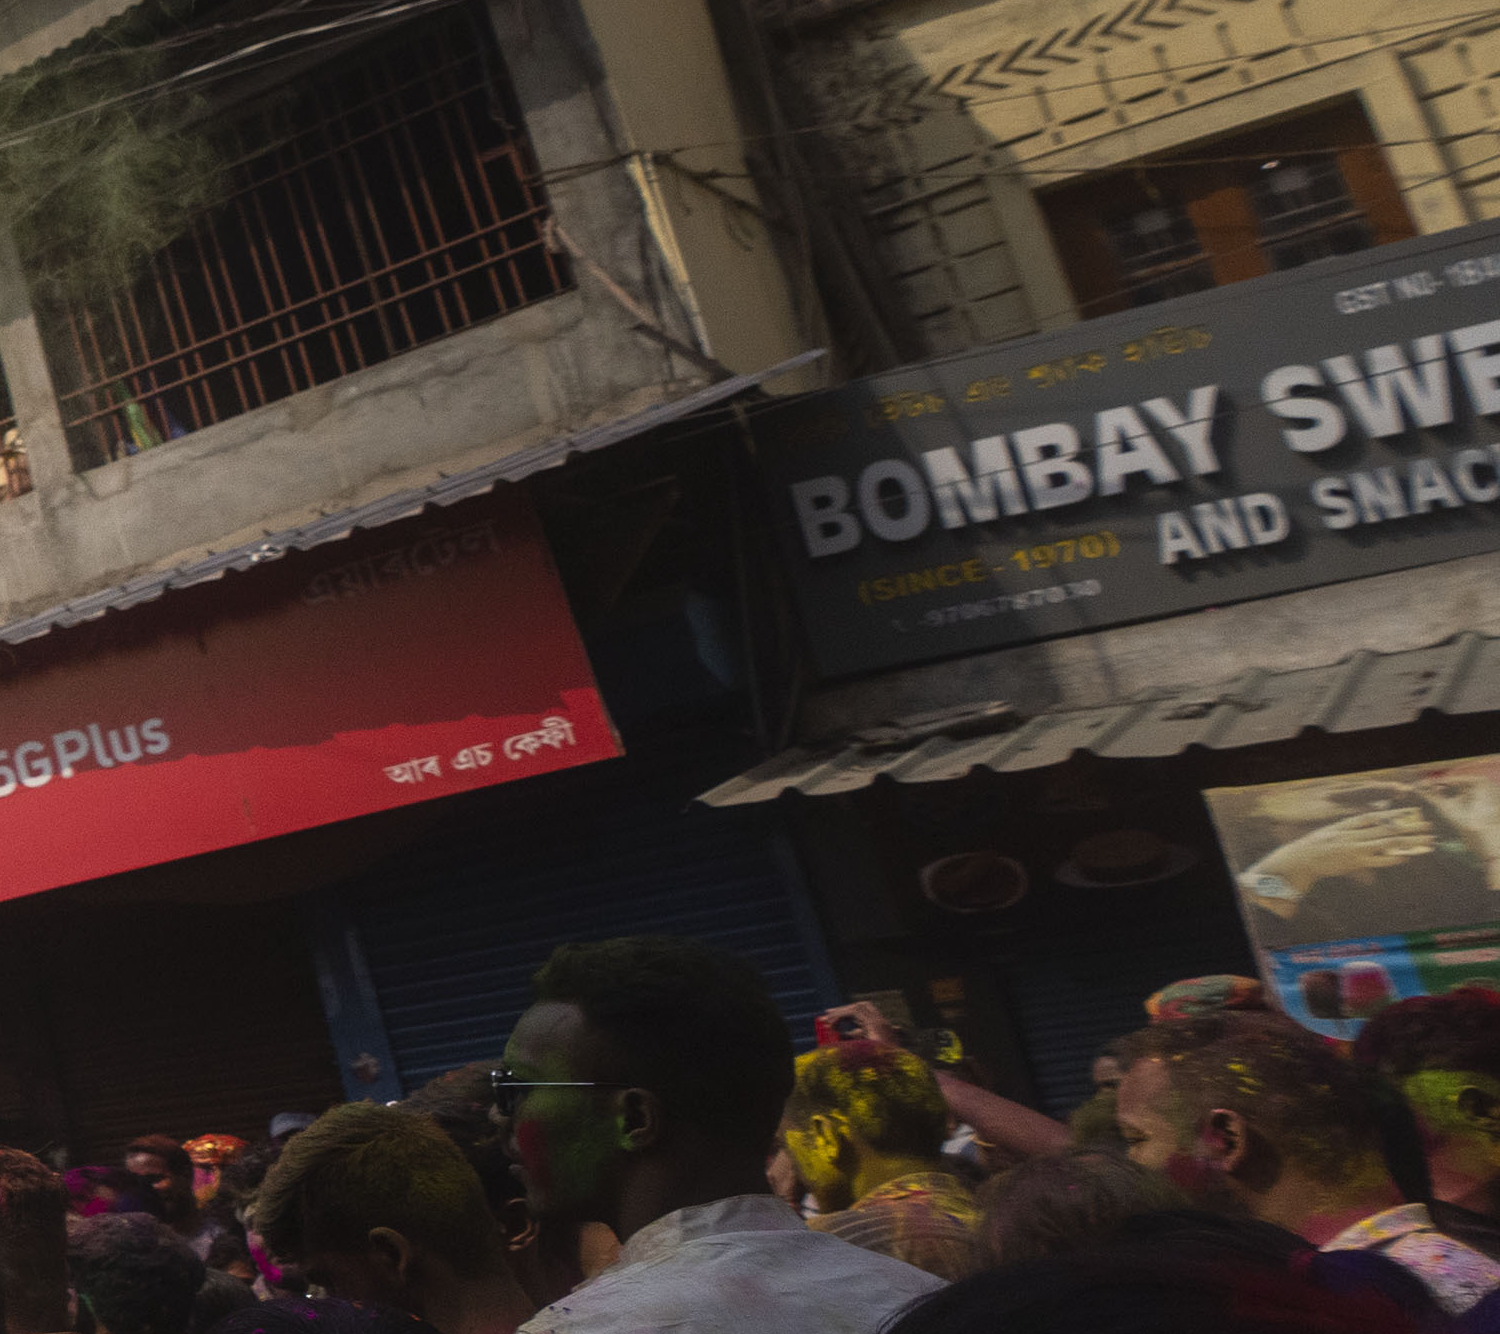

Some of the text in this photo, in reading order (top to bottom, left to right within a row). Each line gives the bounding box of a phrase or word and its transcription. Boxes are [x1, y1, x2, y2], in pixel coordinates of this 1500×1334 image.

[791, 384, 1221, 559] BOMBAY
[1158, 443, 1500, 565] AND SNAC
